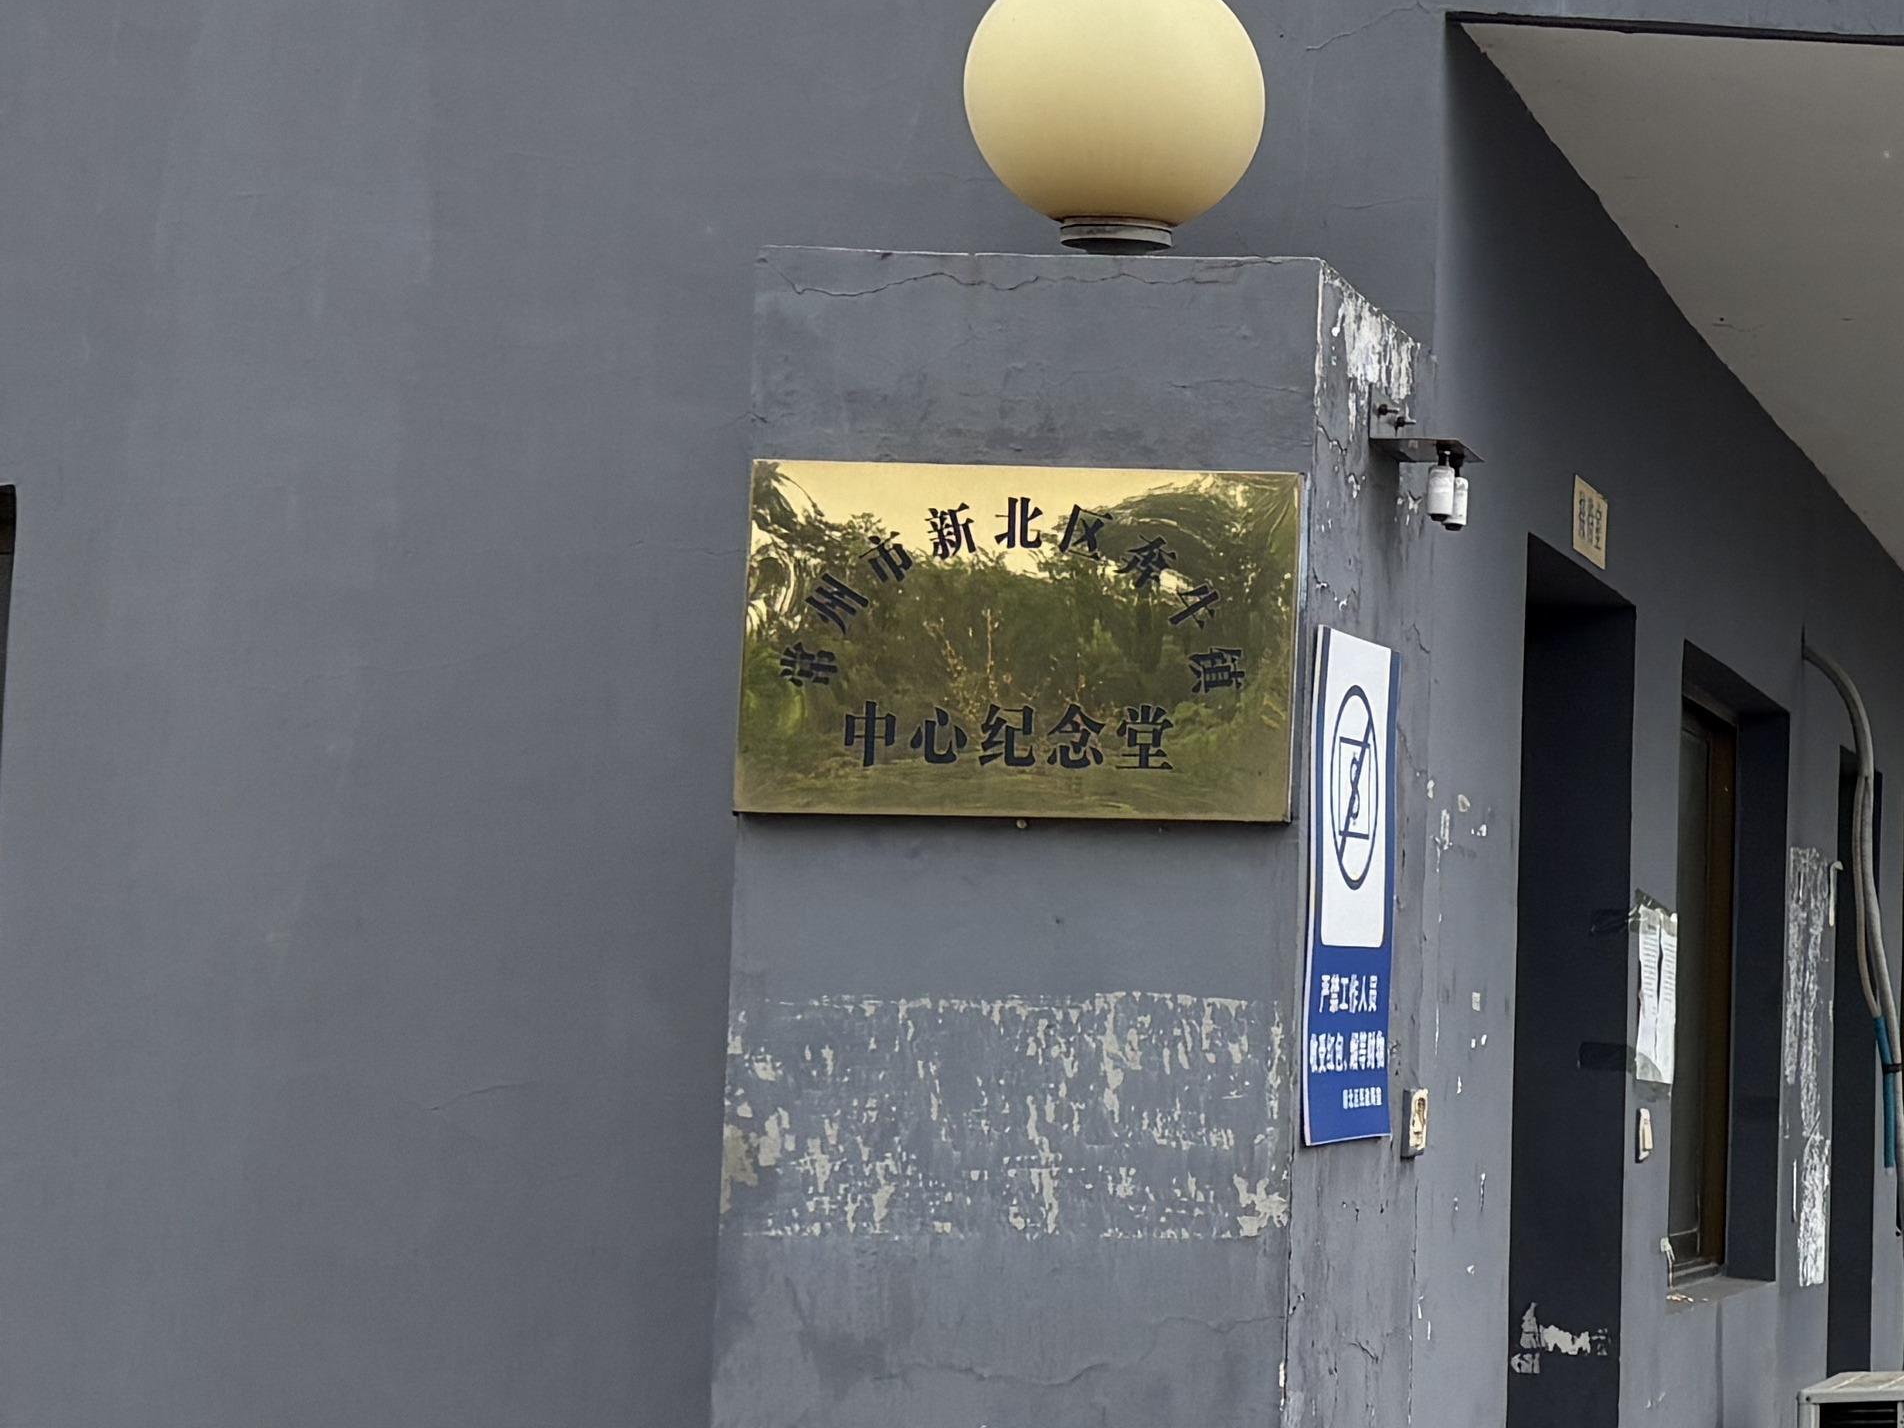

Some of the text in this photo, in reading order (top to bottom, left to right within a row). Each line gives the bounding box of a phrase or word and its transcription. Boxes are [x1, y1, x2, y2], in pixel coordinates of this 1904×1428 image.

[779, 497, 1246, 695] 常州市新北区奔牛镇
[844, 700, 1174, 771] 中心纪念堂
[1318, 973, 1378, 1014] 严禁工作人员
